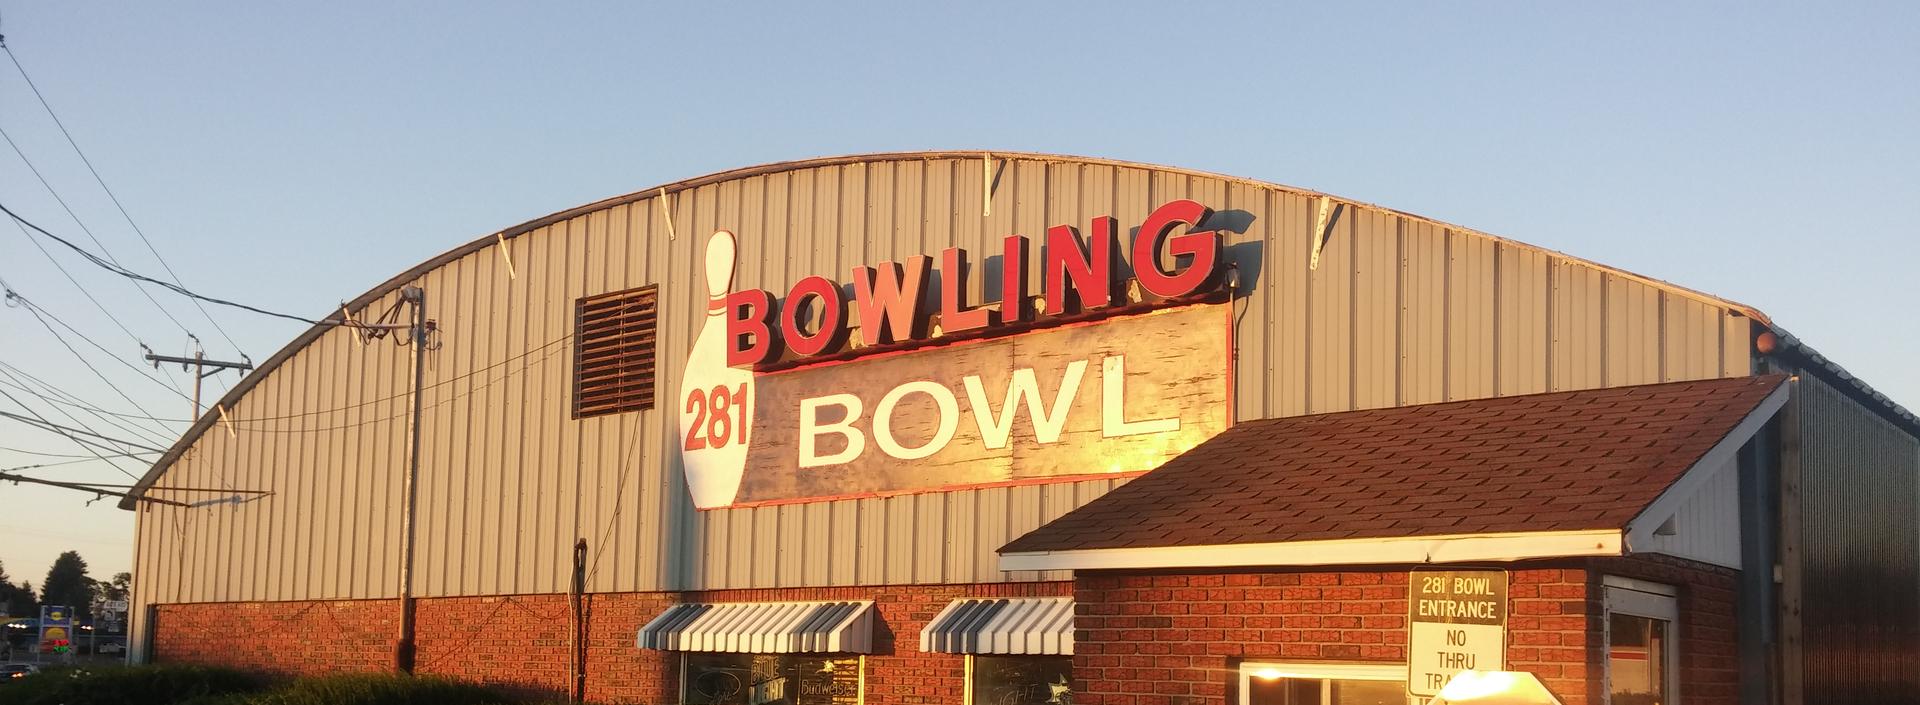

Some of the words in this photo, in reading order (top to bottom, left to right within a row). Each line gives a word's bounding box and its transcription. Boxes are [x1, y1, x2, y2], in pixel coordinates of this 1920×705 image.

[726, 199, 1222, 368] BOWLING
[685, 381, 748, 452] 281
[799, 354, 1182, 468] BOWL
[1422, 577, 1446, 594] 281
[1454, 577, 1495, 595] BOWL
[1419, 599, 1497, 619] ENTRANCE
[1446, 629, 1467, 647] NO
[1437, 651, 1476, 670] THRU
